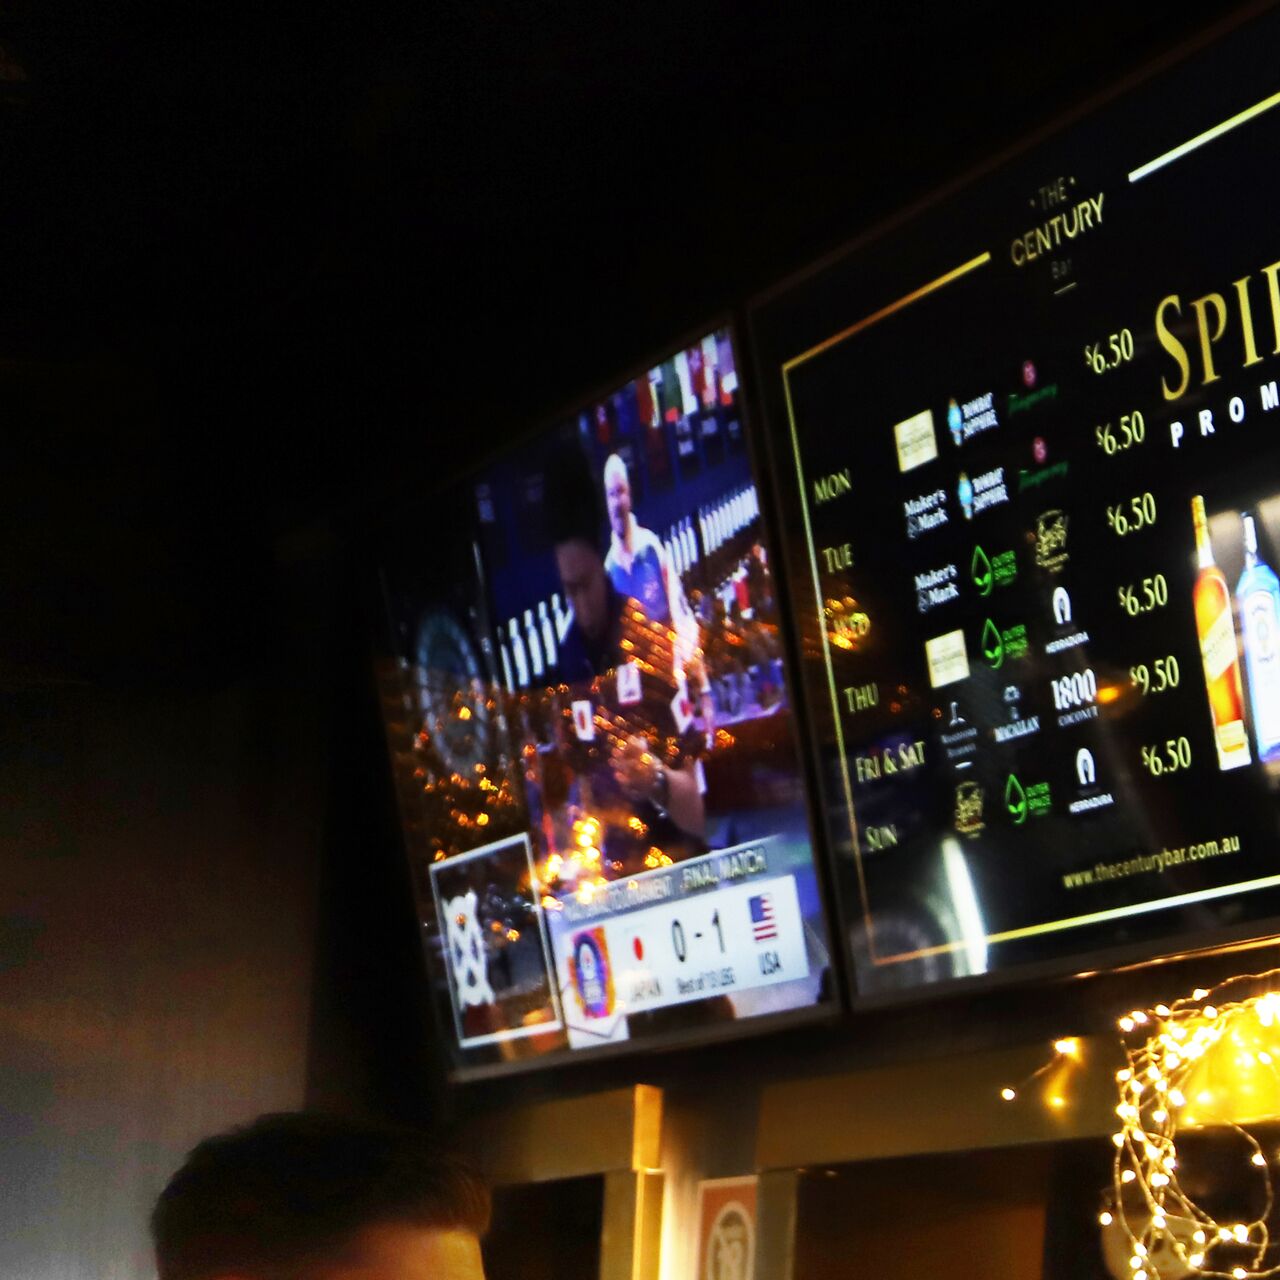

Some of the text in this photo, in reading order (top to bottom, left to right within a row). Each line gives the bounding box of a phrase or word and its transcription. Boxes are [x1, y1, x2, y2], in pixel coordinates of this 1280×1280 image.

[1011, 192, 1104, 266] CENTURY
[1085, 328, 1134, 374] $6.50
[1096, 410, 1145, 455] $6.50
[814, 467, 851, 504] MON
[918, 506, 949, 532] Mark
[1106, 492, 1157, 537] $6.50
[823, 543, 853, 574] TUE
[928, 581, 959, 607] Mark
[1118, 574, 1168, 617] $6.50
[1051, 668, 1098, 711] 1800
[1129, 655, 1180, 696] $9.50
[844, 682, 879, 714] THU
[856, 755, 882, 784] FRI
[884, 747, 898, 775] &
[900, 741, 926, 771] SAT
[1141, 736, 1192, 776] $6.50
[865, 823, 898, 852] SUN
[1062, 835, 1241, 889] www.thecenturybar.com.au
[671, 918, 687, 963] 0
[712, 906, 727, 954] 1
[758, 950, 783, 977] USA
